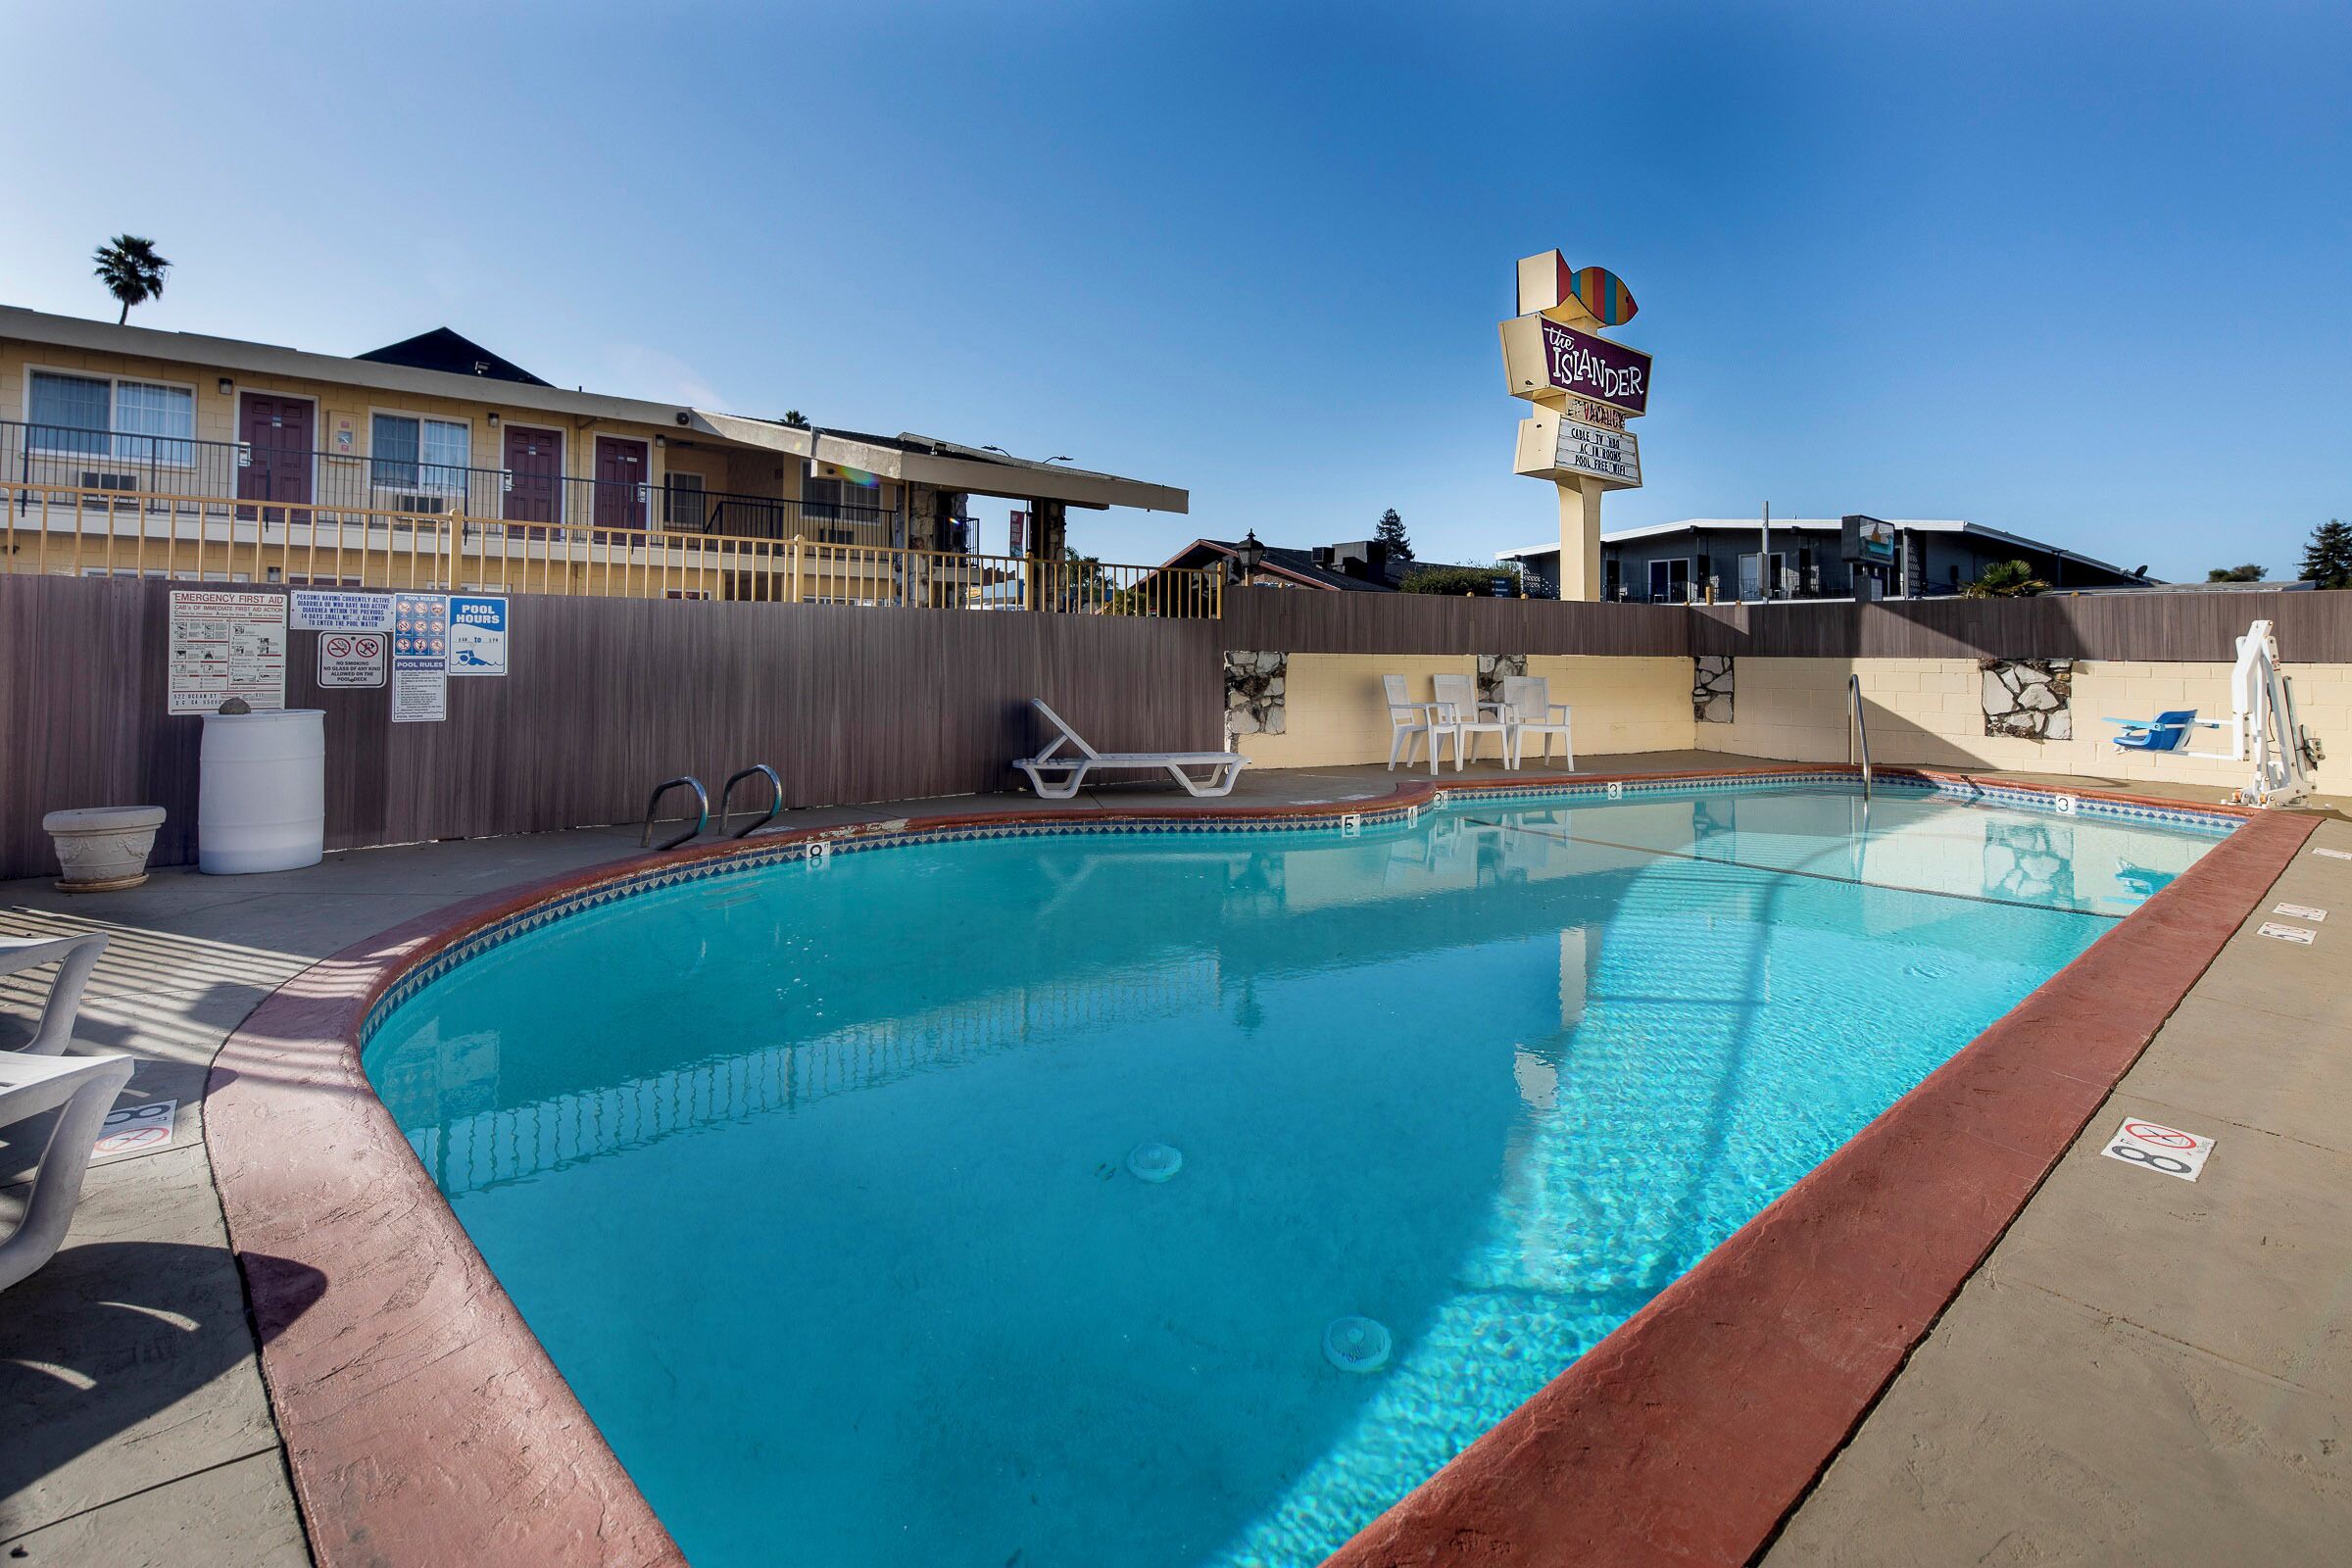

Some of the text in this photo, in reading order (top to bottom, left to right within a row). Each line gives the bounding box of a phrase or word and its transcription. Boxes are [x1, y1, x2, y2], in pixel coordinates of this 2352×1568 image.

[1544, 327, 1574, 350] the
[1553, 347, 1644, 397] ISLANDER
[1580, 443, 1587, 454] AC
[1592, 447, 1599, 457] IN
[1576, 455, 1590, 467] POOL
[1594, 459, 1608, 471] FREE
[175, 593, 235, 602] EMERGENCY
[239, 595, 265, 603] FIRST
[462, 605, 495, 614] POOL
[456, 614, 500, 624] HOURS
[1610, 784, 1617, 798] 3
[1434, 792, 1442, 808] 3
[2058, 798, 2068, 812] 3
[103, 1104, 171, 1126] 8
[2111, 1146, 2192, 1174] 8
